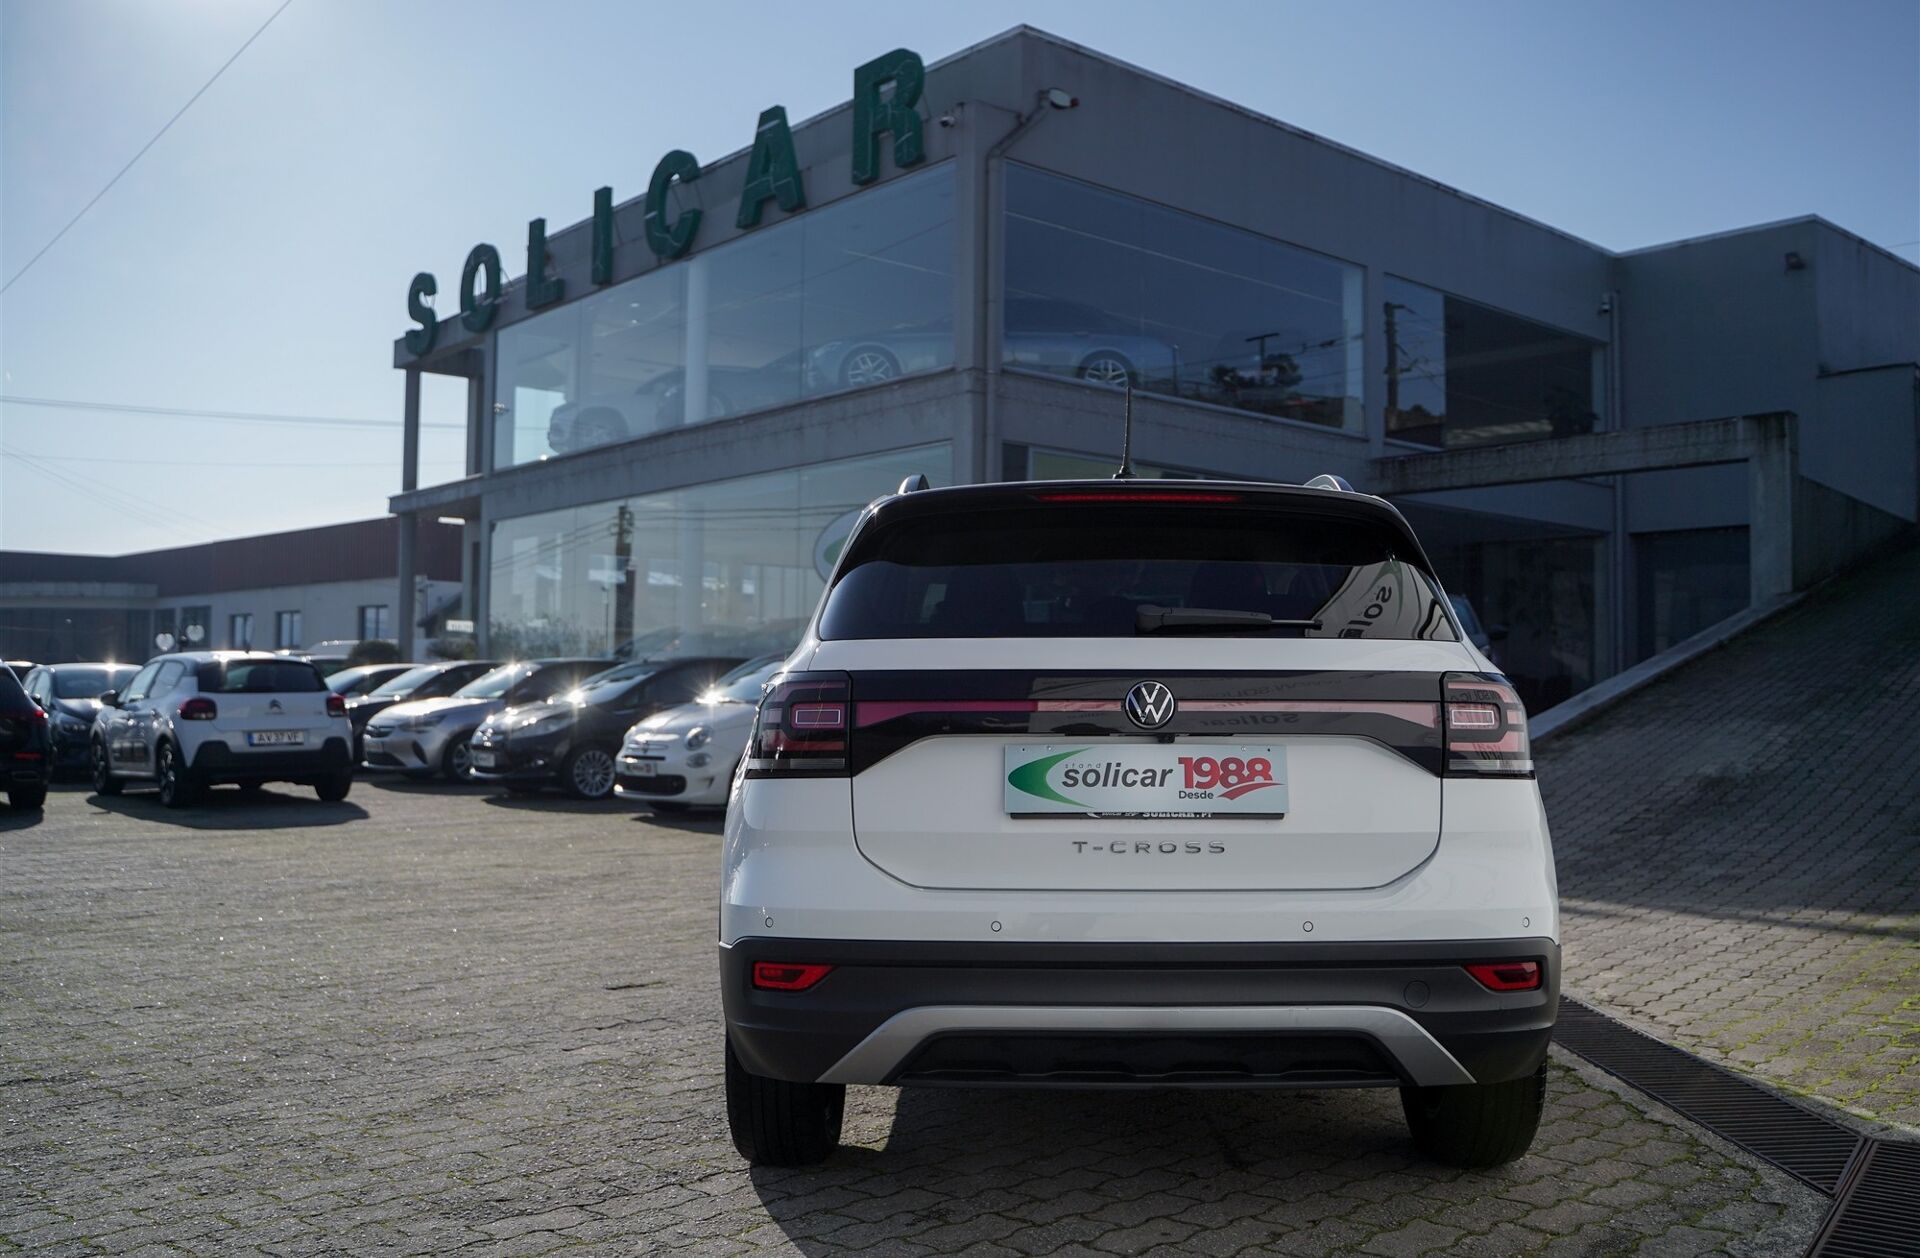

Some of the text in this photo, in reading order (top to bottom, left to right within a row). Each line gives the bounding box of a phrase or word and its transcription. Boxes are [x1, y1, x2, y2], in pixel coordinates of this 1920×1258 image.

[405, 48, 925, 356] SOLICAR
[1061, 757, 1273, 789] solicar 1988
[1178, 790, 1214, 800] Desde
[1072, 840, 1226, 854] T-CROSS
